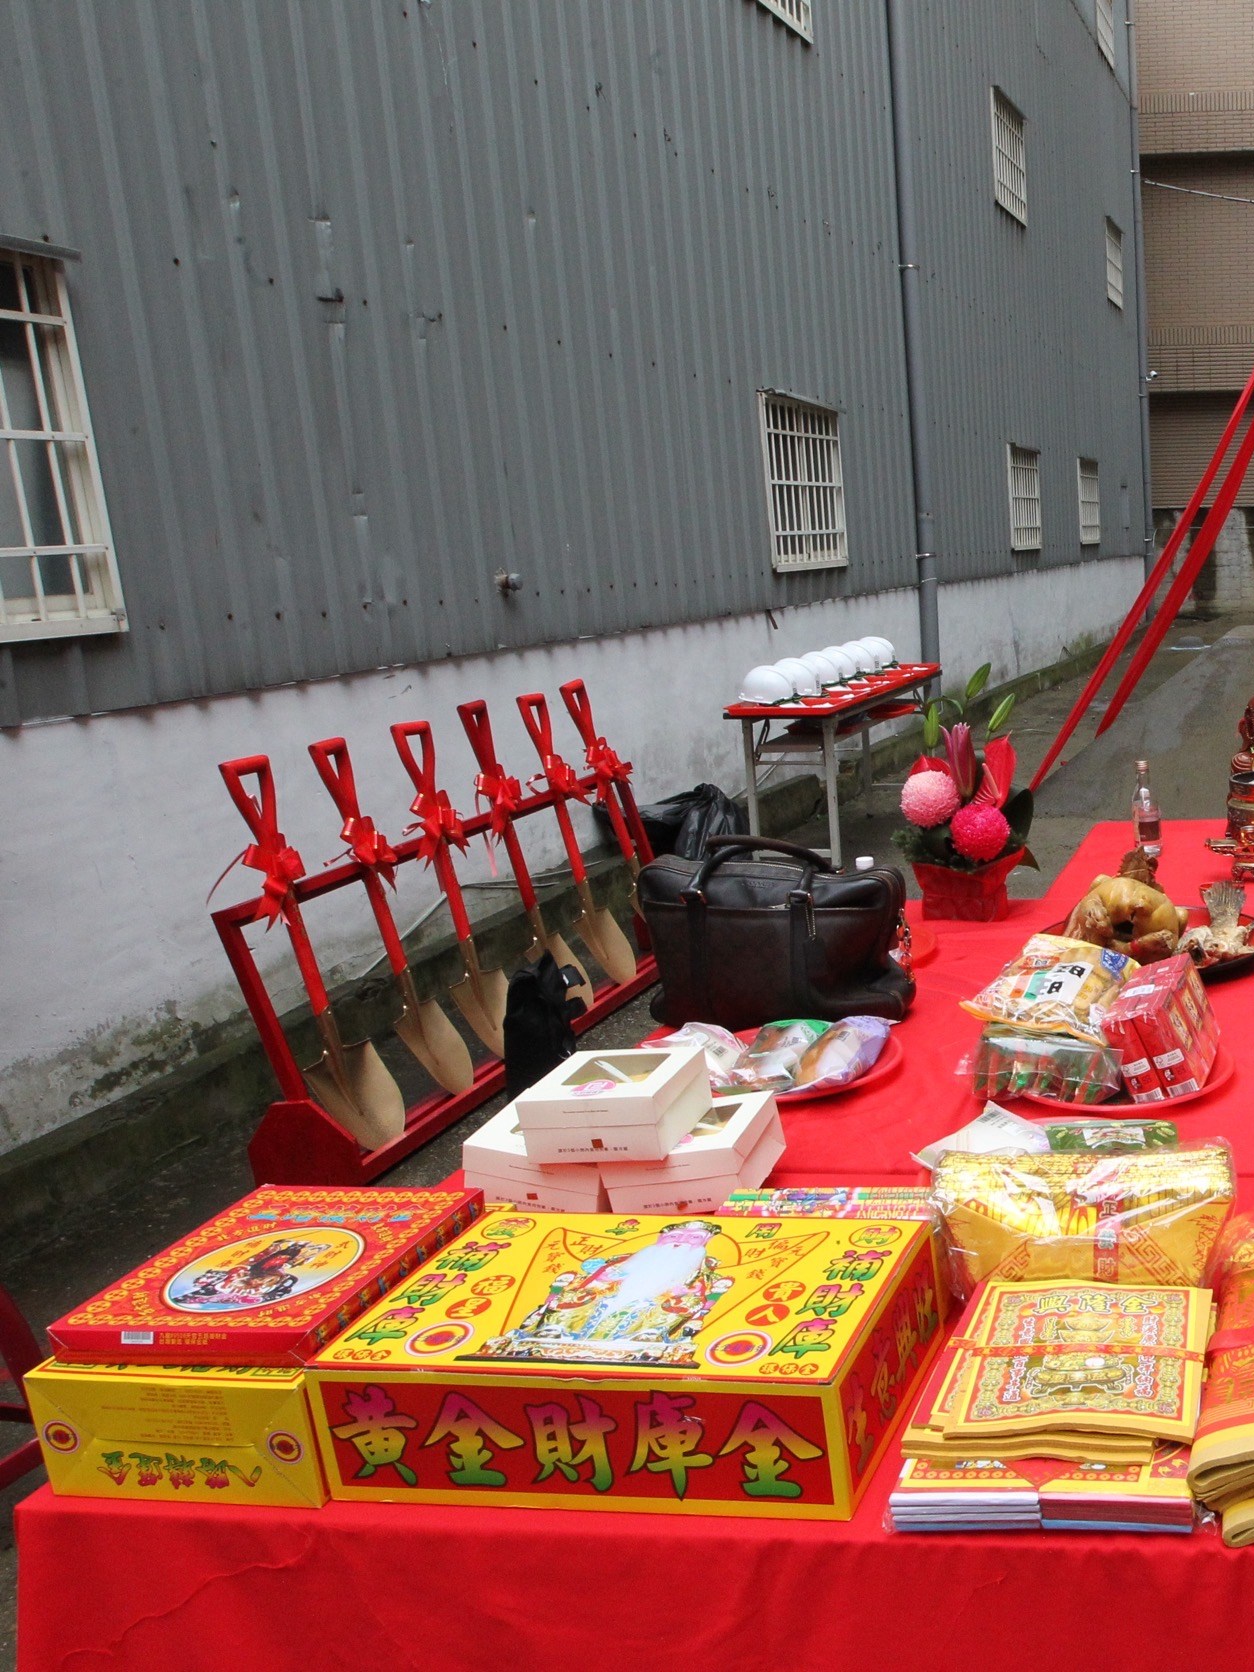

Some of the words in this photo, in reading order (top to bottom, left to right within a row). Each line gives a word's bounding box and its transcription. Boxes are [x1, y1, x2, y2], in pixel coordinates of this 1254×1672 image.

[745, 1222, 783, 1239] 用
[857, 1226, 899, 1245] 財
[344, 1241, 512, 1346] 補財庫
[451, 1276, 509, 1318] 福星
[749, 1281, 803, 1324] 貴人
[768, 1249, 892, 1359] 補財庫
[331, 1384, 824, 1501] 黃金財庫金
